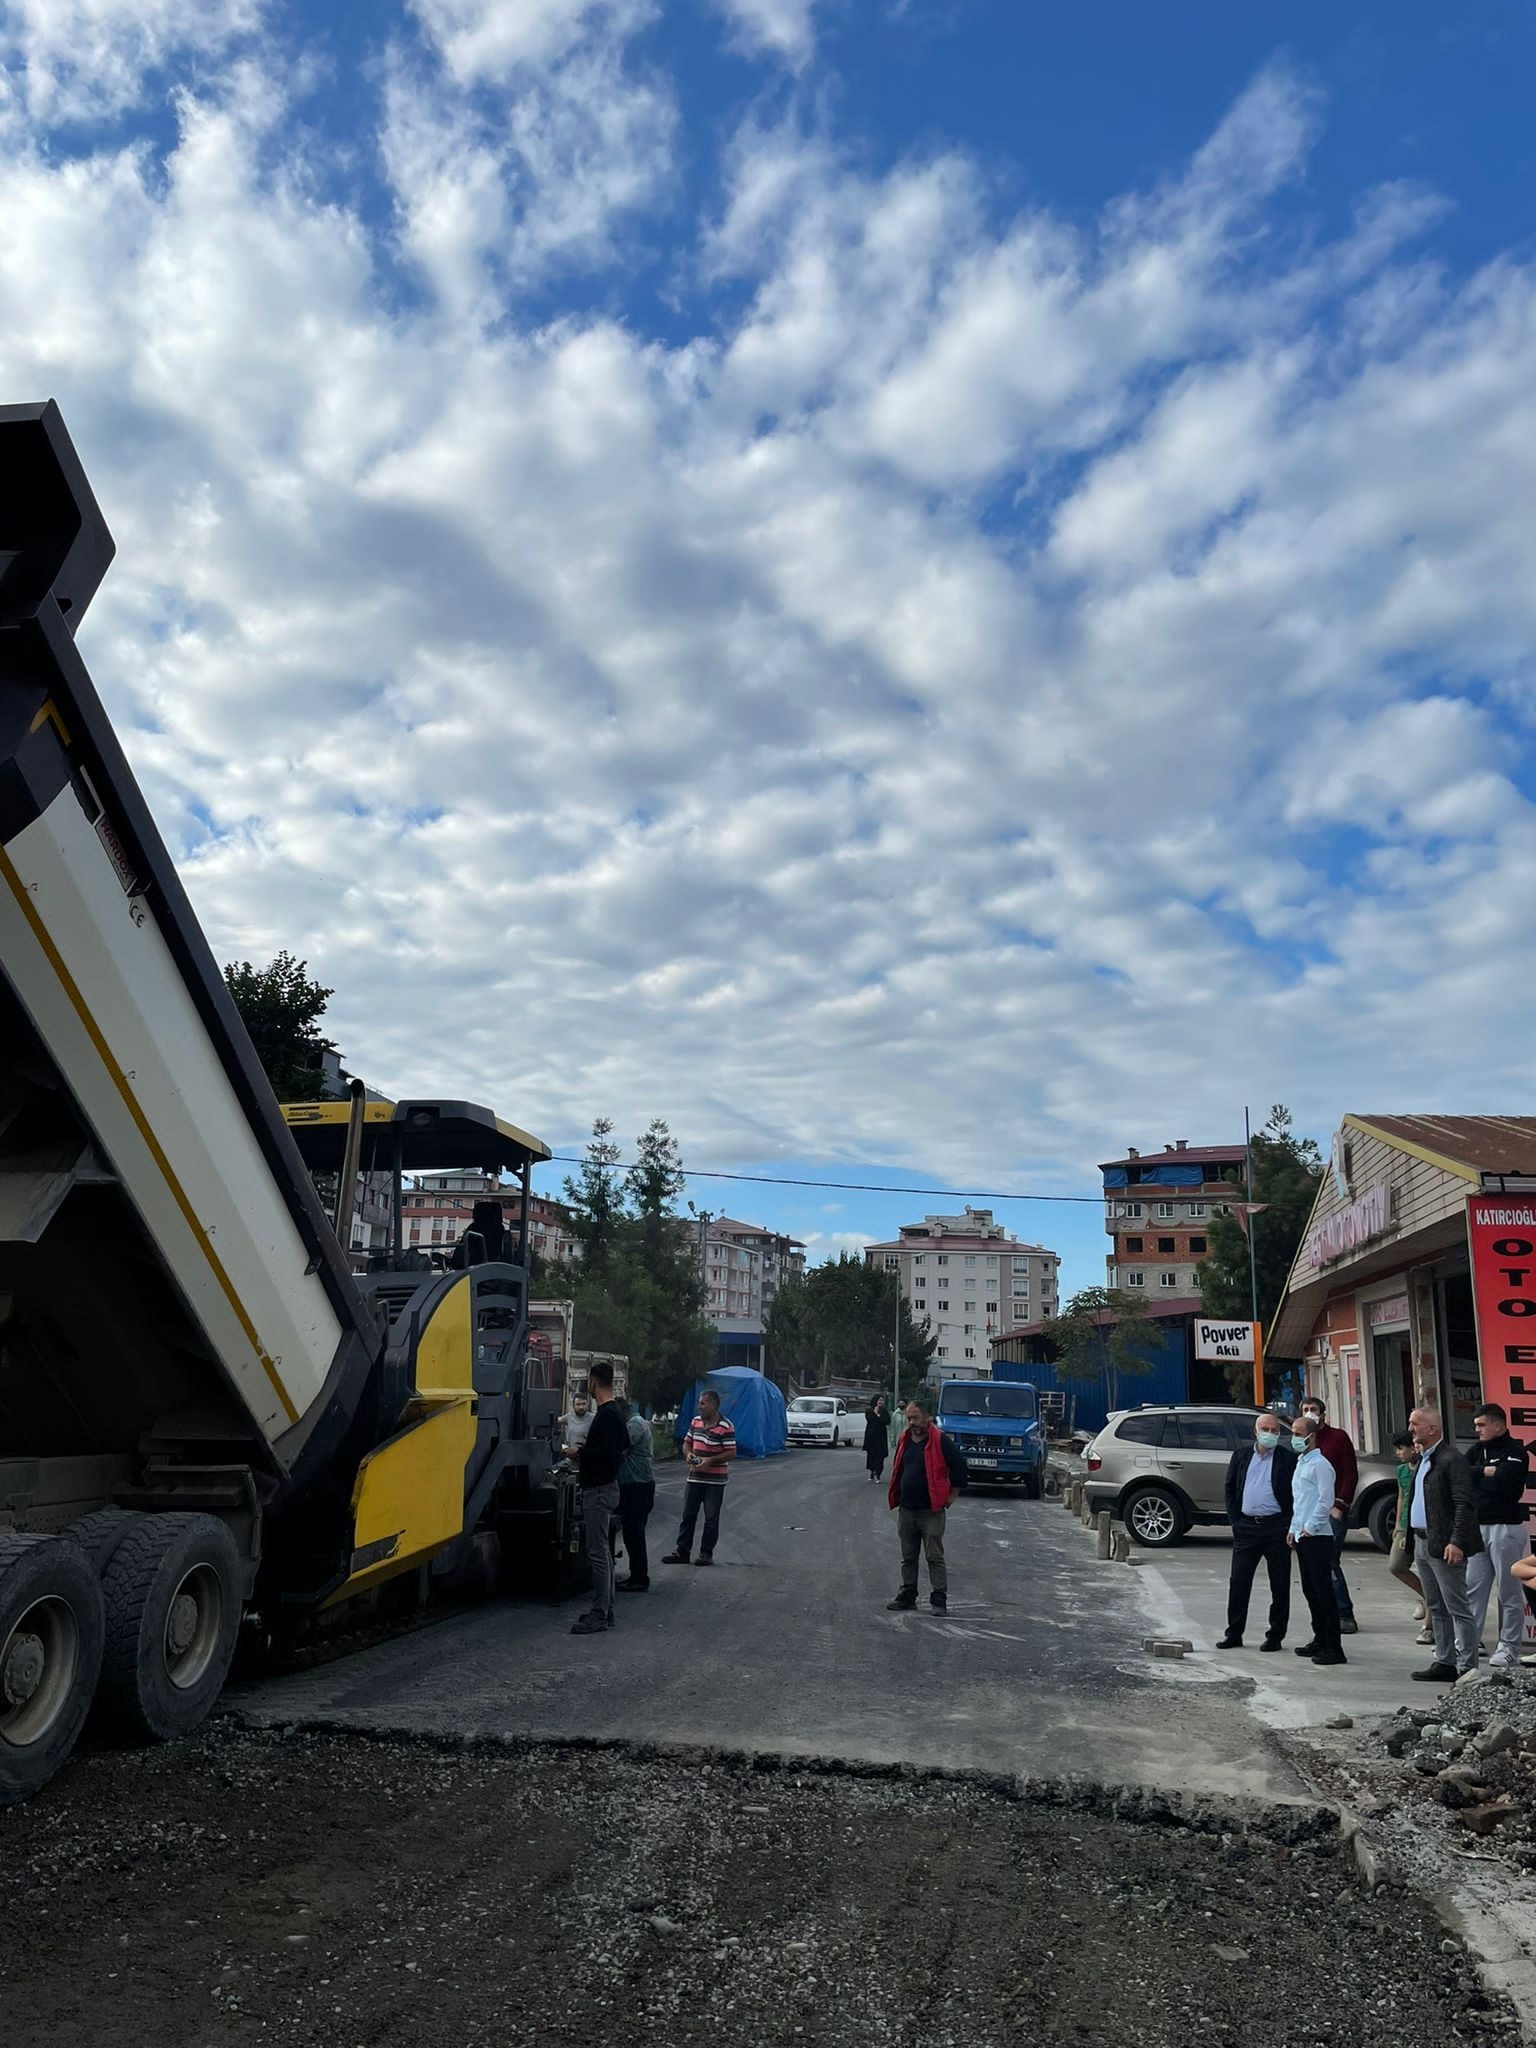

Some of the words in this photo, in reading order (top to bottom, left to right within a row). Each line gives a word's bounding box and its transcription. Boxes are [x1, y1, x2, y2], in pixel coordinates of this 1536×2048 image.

[100, 822, 131, 880] HARDOX
[1476, 1205, 1536, 1225] KATIRCIOĞL
[1201, 1326, 1250, 1344] Povver
[1216, 1345, 1240, 1356] Akü
